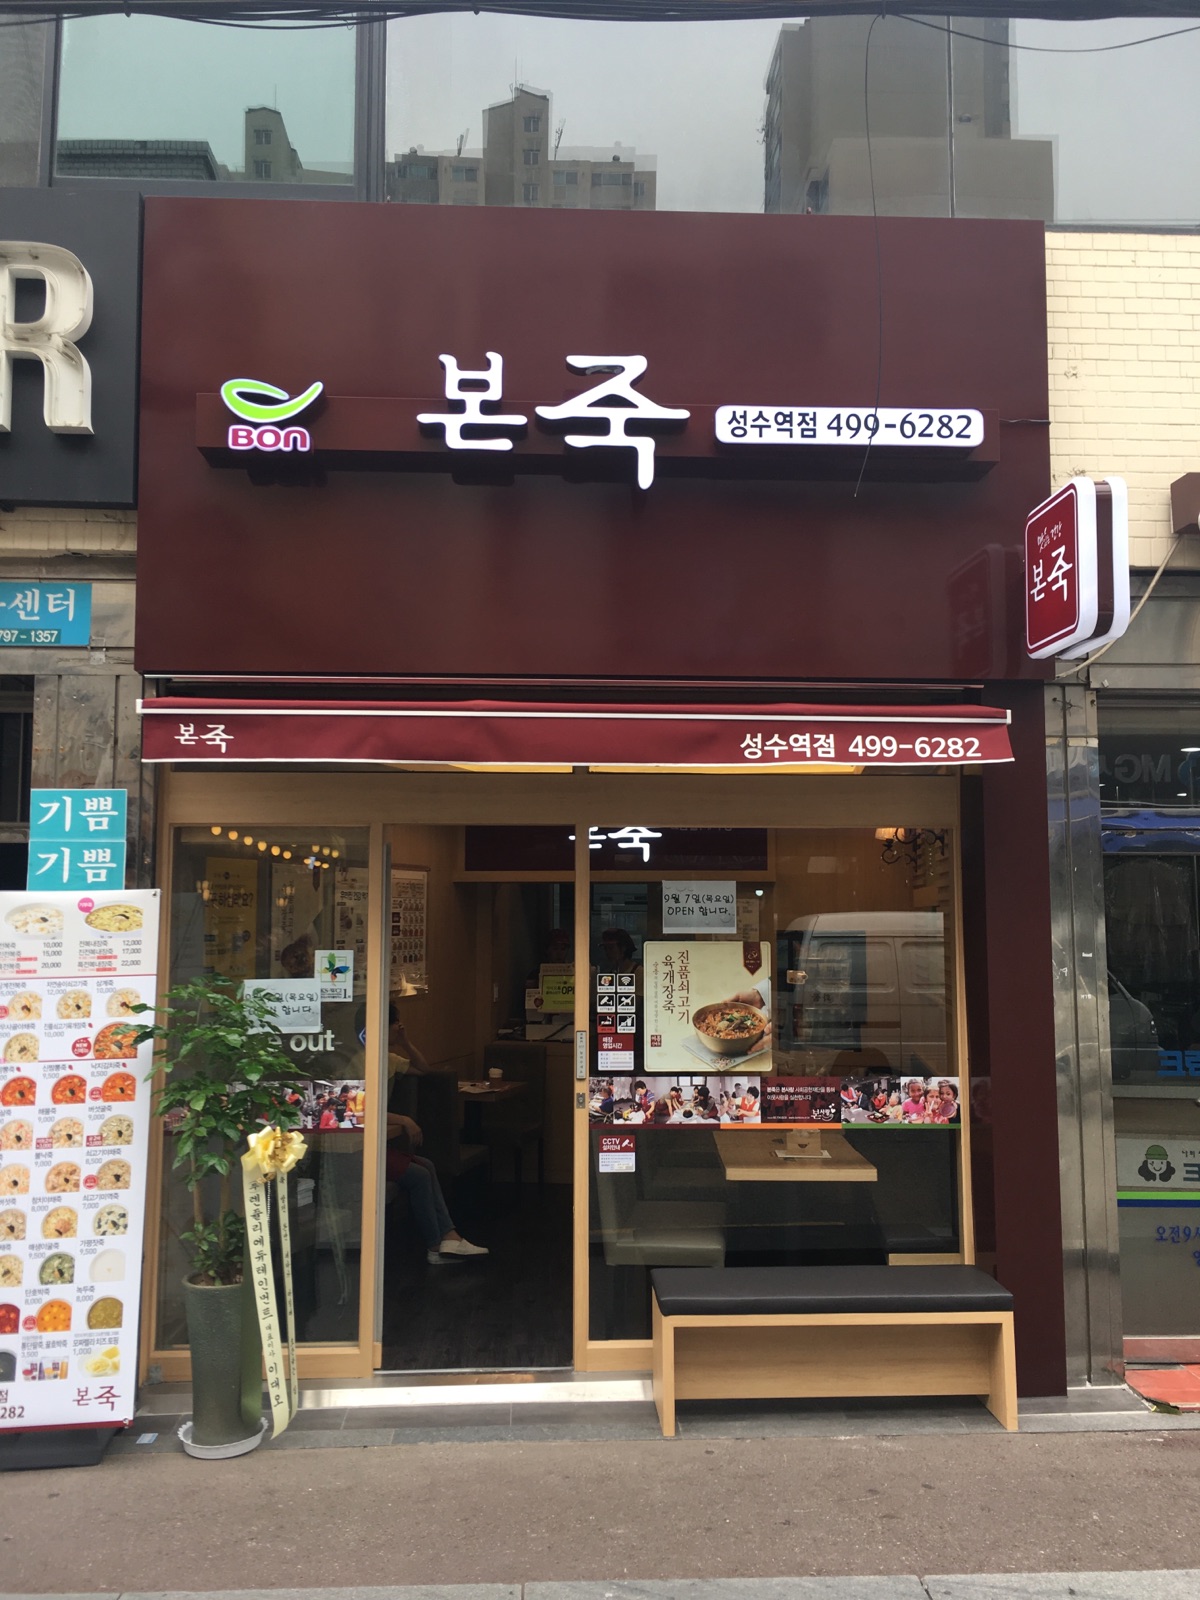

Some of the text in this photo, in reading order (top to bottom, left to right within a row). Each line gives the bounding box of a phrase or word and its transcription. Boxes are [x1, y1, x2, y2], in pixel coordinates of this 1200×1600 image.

[0, 241, 94, 434] R
[417, 351, 690, 490] 본죽
[727, 410, 973, 440] 성수역점 499-6282
[1030, 545, 1073, 602] 본죽
[0, 588, 75, 621] 센터
[174, 723, 235, 754] 본죽
[740, 733, 982, 759] 성수역점 499-6282
[37, 796, 119, 832] 기쁨
[35, 847, 118, 884] 기쁨
[667, 906, 694, 916] OPEN
[122, 939, 142, 947] 12,000
[662, 954, 675, 1014] 육개장죽
[677, 950, 690, 1025] 진품쇠고기
[290, 1029, 335, 1052] out
[72, 1385, 122, 1411] 본죽
